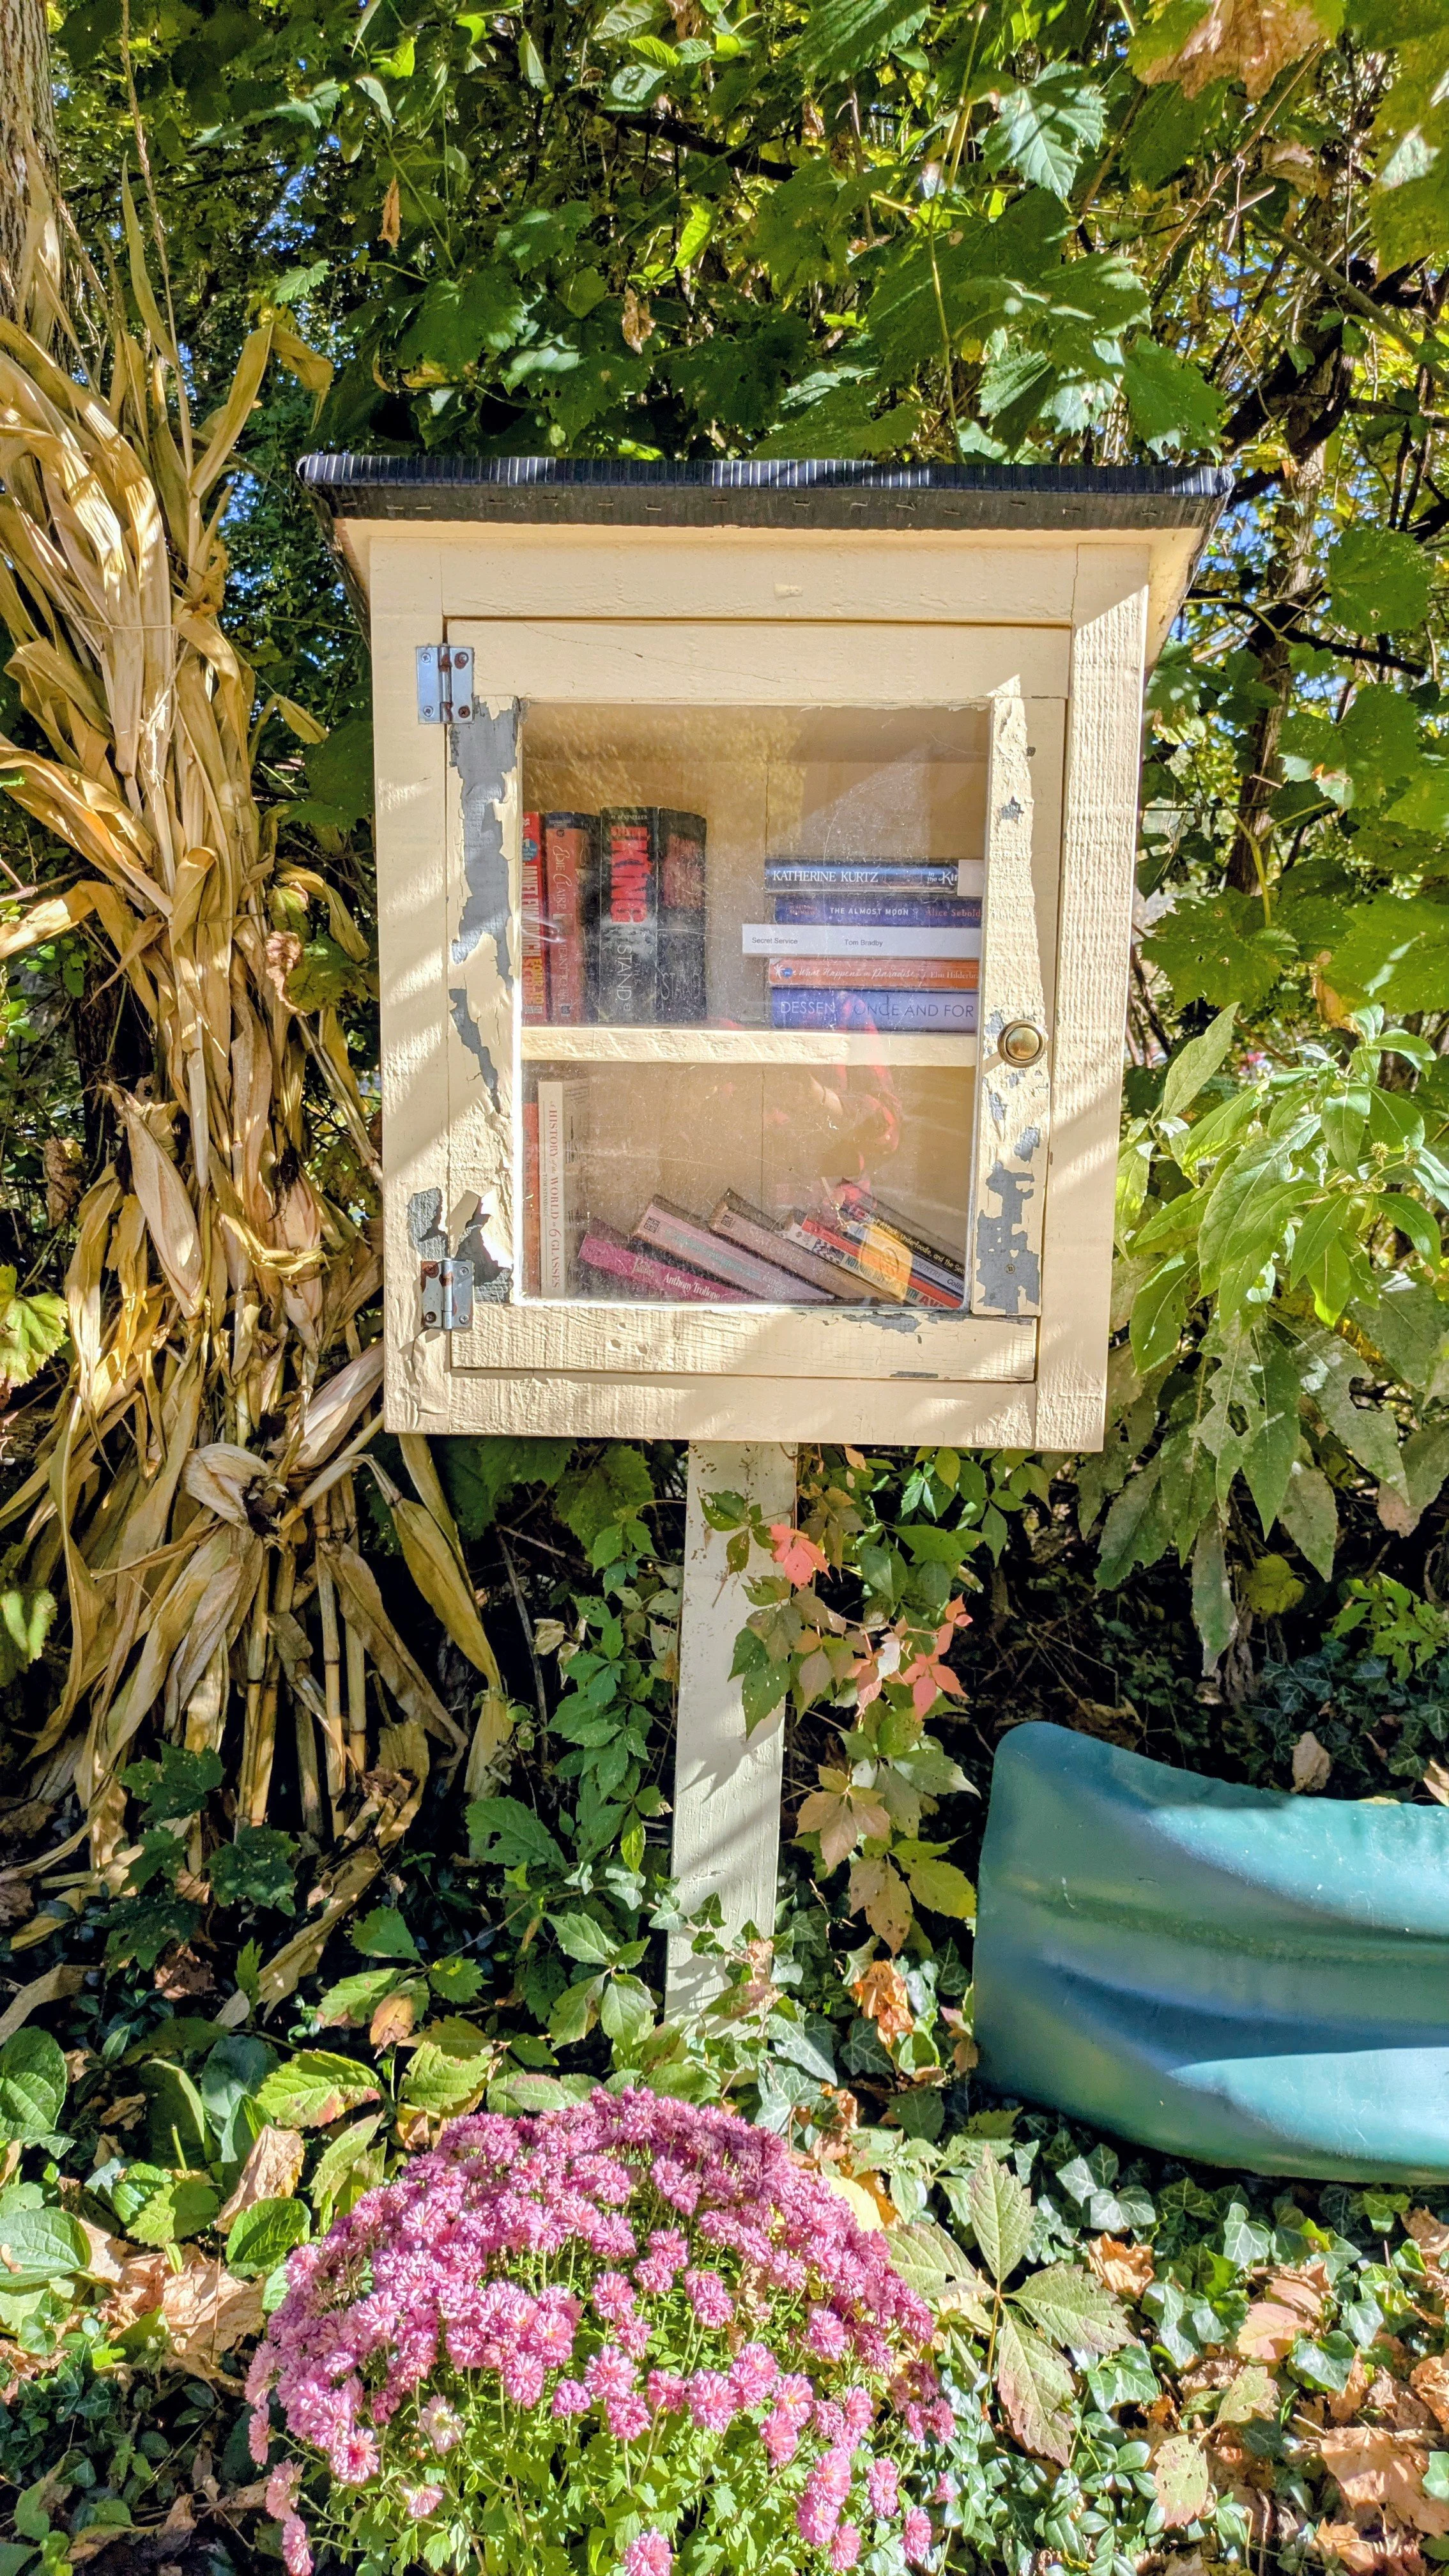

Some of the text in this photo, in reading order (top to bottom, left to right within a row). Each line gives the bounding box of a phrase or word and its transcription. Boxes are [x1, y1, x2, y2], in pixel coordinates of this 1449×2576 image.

[521, 866, 538, 895] JANET
[610, 840, 649, 923] KING
[773, 870, 878, 883] KATHERINE KURTZ
[926, 907, 981, 917] Alice Sebold
[521, 898, 541, 956] EVANOVICH
[617, 944, 632, 1000] STAND
[799, 968, 820, 976] What
[781, 1000, 835, 1014] DESSEN
[854, 1003, 974, 1017] ONCE AND FOR
[549, 1110, 558, 1156] HISTORY
[549, 1177, 559, 1220] WORLD
[548, 1228, 562, 1238] 6
[877, 1221, 898, 1238] Attack,
[933, 1253, 946, 1263] and
[945, 1258, 956, 1269] the
[551, 1240, 561, 1289] GLASSES
[912, 1259, 944, 1278] COUNTRY
[663, 1272, 721, 1301] Anthony Trollope
